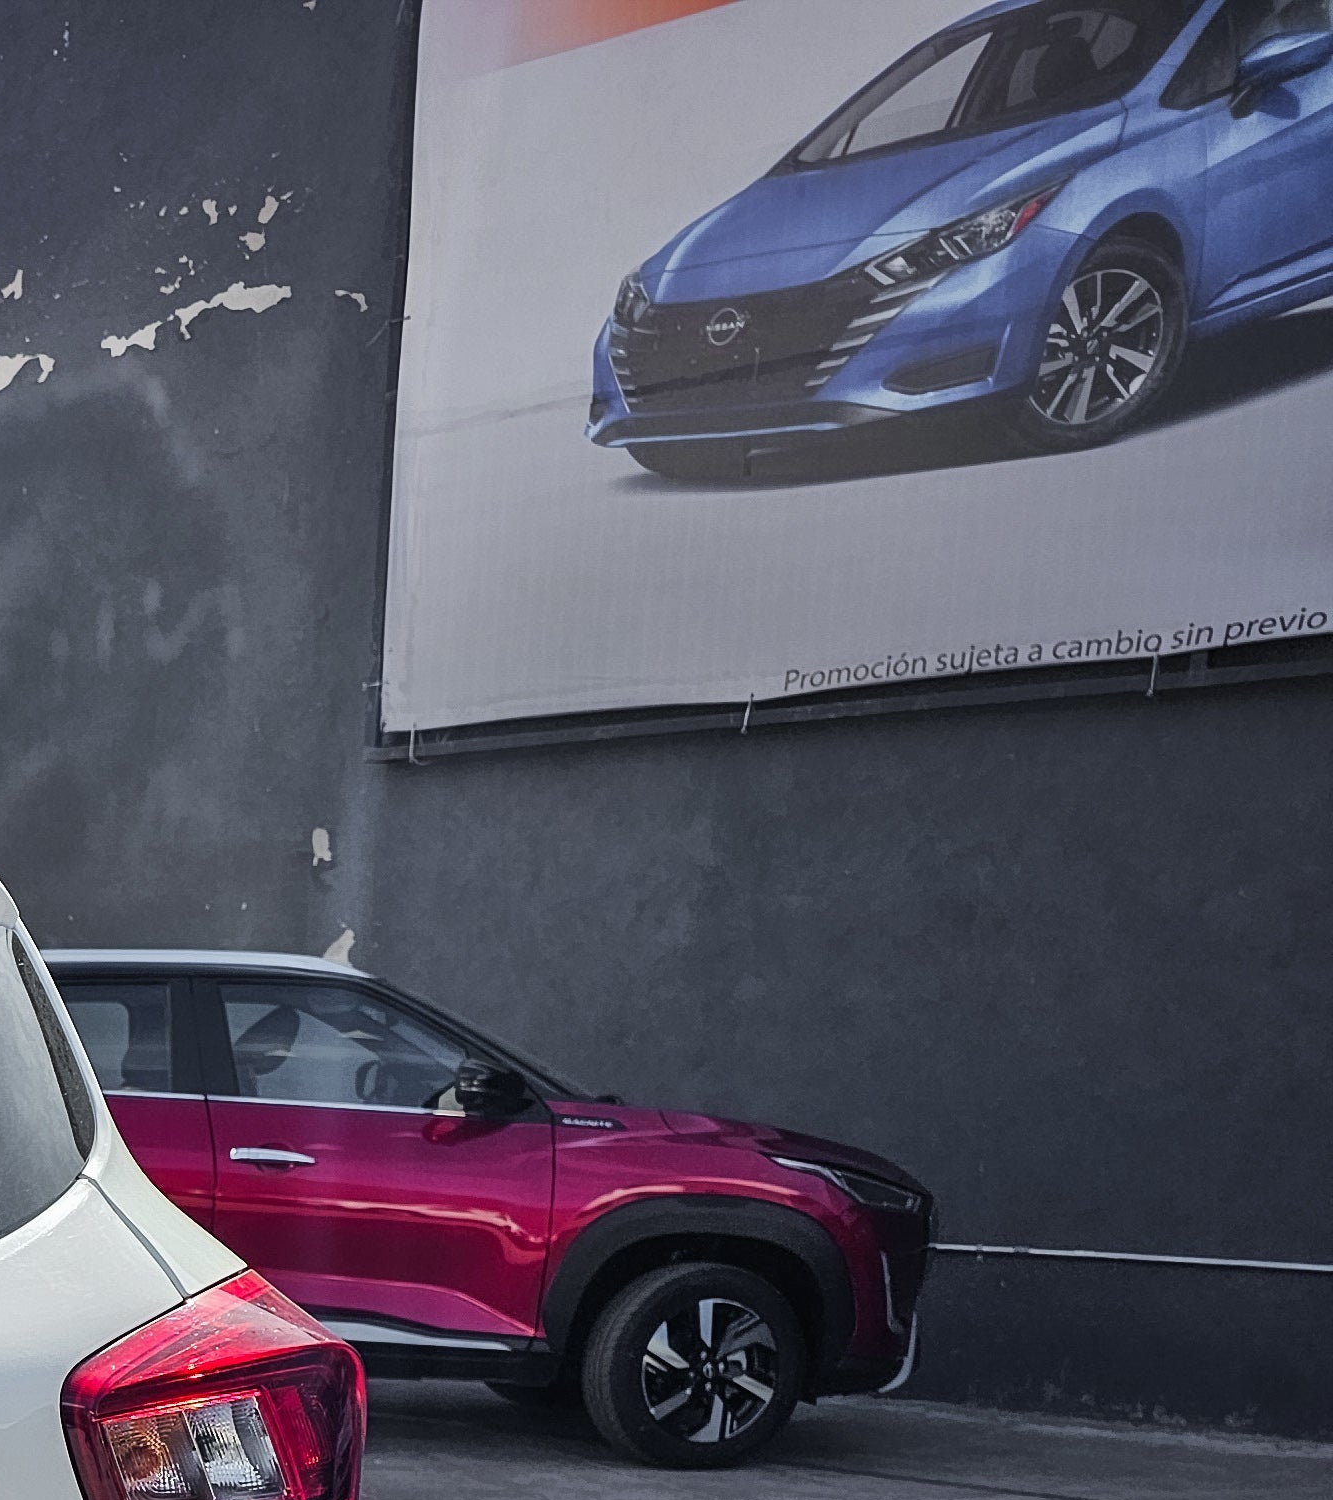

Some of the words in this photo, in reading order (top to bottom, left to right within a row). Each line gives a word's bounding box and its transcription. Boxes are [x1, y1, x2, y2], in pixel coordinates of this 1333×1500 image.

[783, 652, 928, 693] Promoción
[935, 641, 1020, 675] sujeta
[1027, 644, 1043, 663] a
[1051, 629, 1163, 660] cambio
[1170, 623, 1215, 650] sin
[1223, 606, 1328, 646] previo
